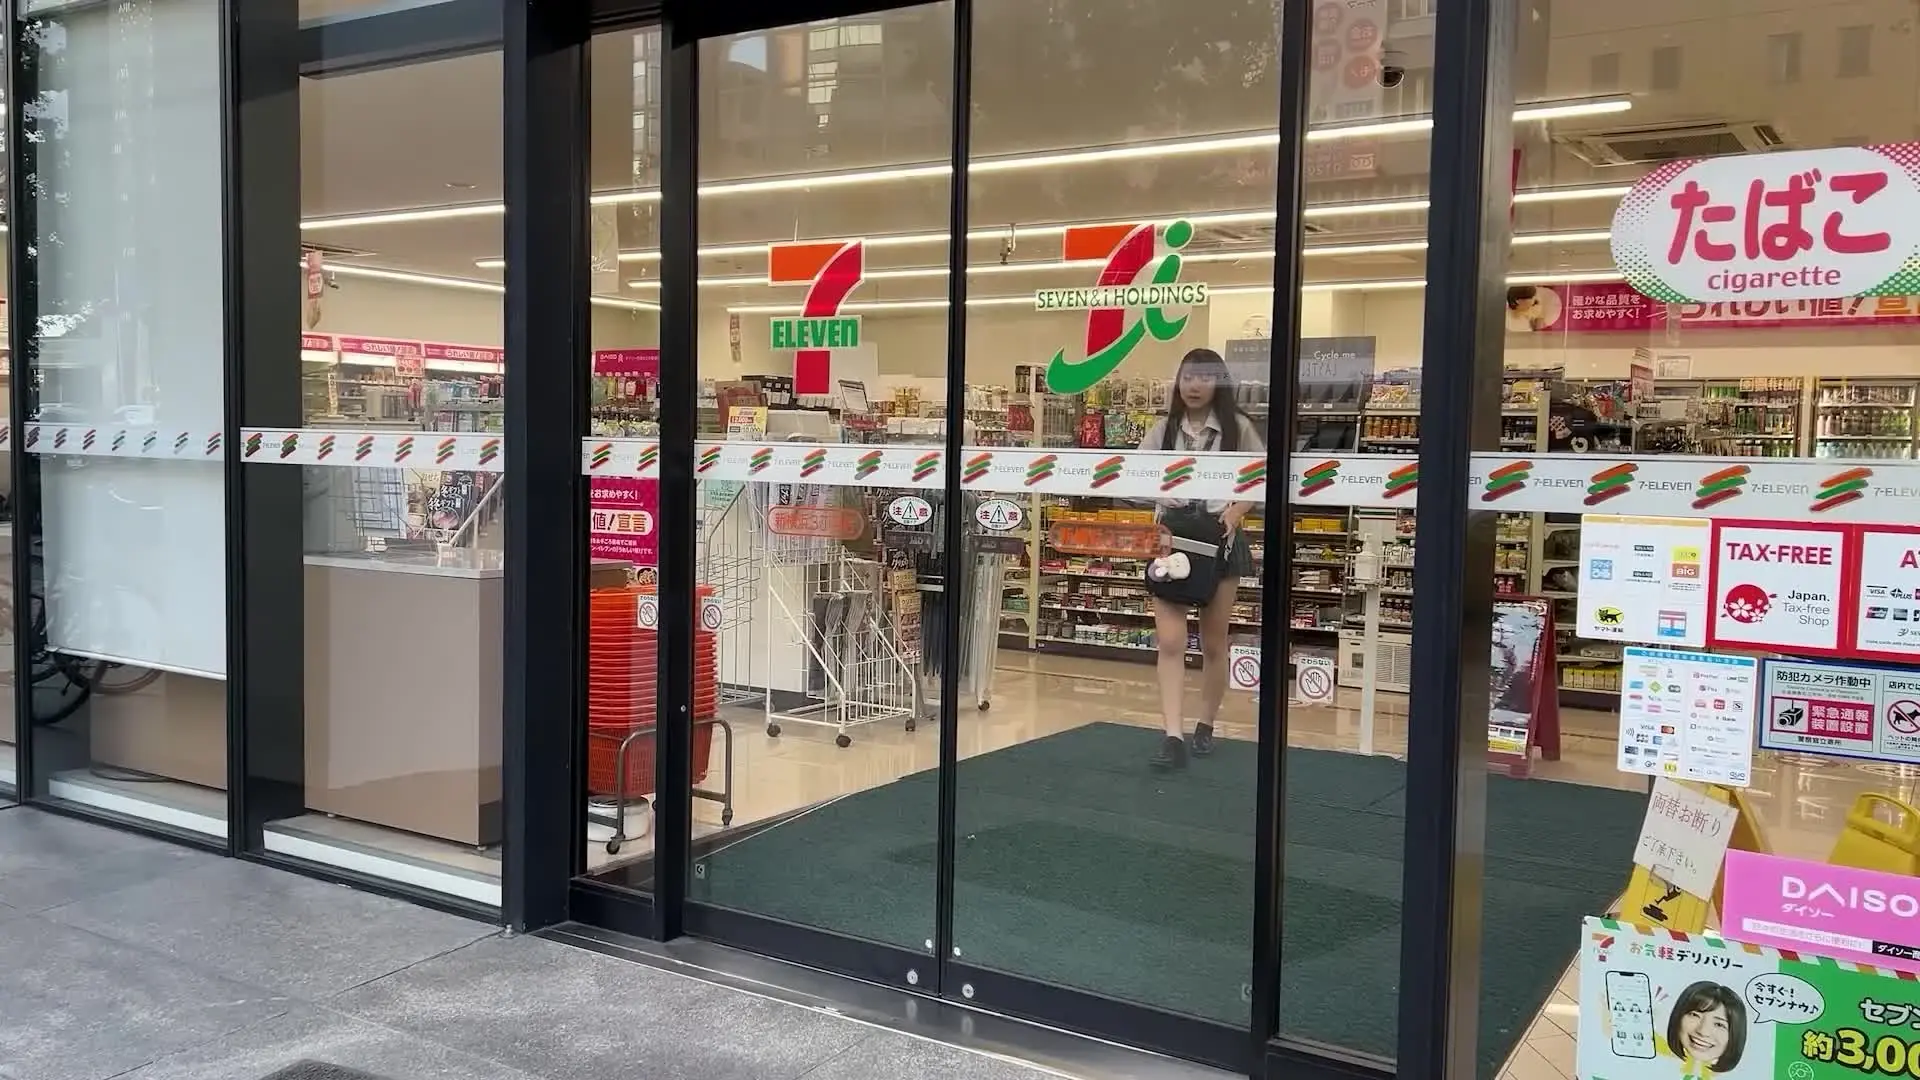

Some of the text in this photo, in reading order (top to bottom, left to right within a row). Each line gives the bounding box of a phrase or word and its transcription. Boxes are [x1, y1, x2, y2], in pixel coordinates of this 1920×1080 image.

[1668, 168, 1891, 265] たばこ
[1707, 266, 1841, 293] cigarette
[1114, 284, 1206, 306] HOLDINGS
[1874, 487, 1920, 498] 7-ELEV
[1727, 542, 1833, 566] TAX-FREE
[1900, 550, 1920, 568] A
[1676, 567, 1695, 576] BIG
[1788, 590, 1830, 602] Japan.
[1783, 603, 1830, 614] Tax-free
[1800, 615, 1830, 627] Shop
[1776, 670, 1871, 688] 防犯カメラ作動中
[1811, 705, 1869, 722] 緊急通報
[1811, 719, 1869, 735] 装置設置
[1652, 792, 1721, 836] 両替お断り
[1782, 876, 1919, 917] DAISO
[1782, 902, 1835, 918] ダイソー
[1629, 942, 1743, 969] お気軽デリバリー
